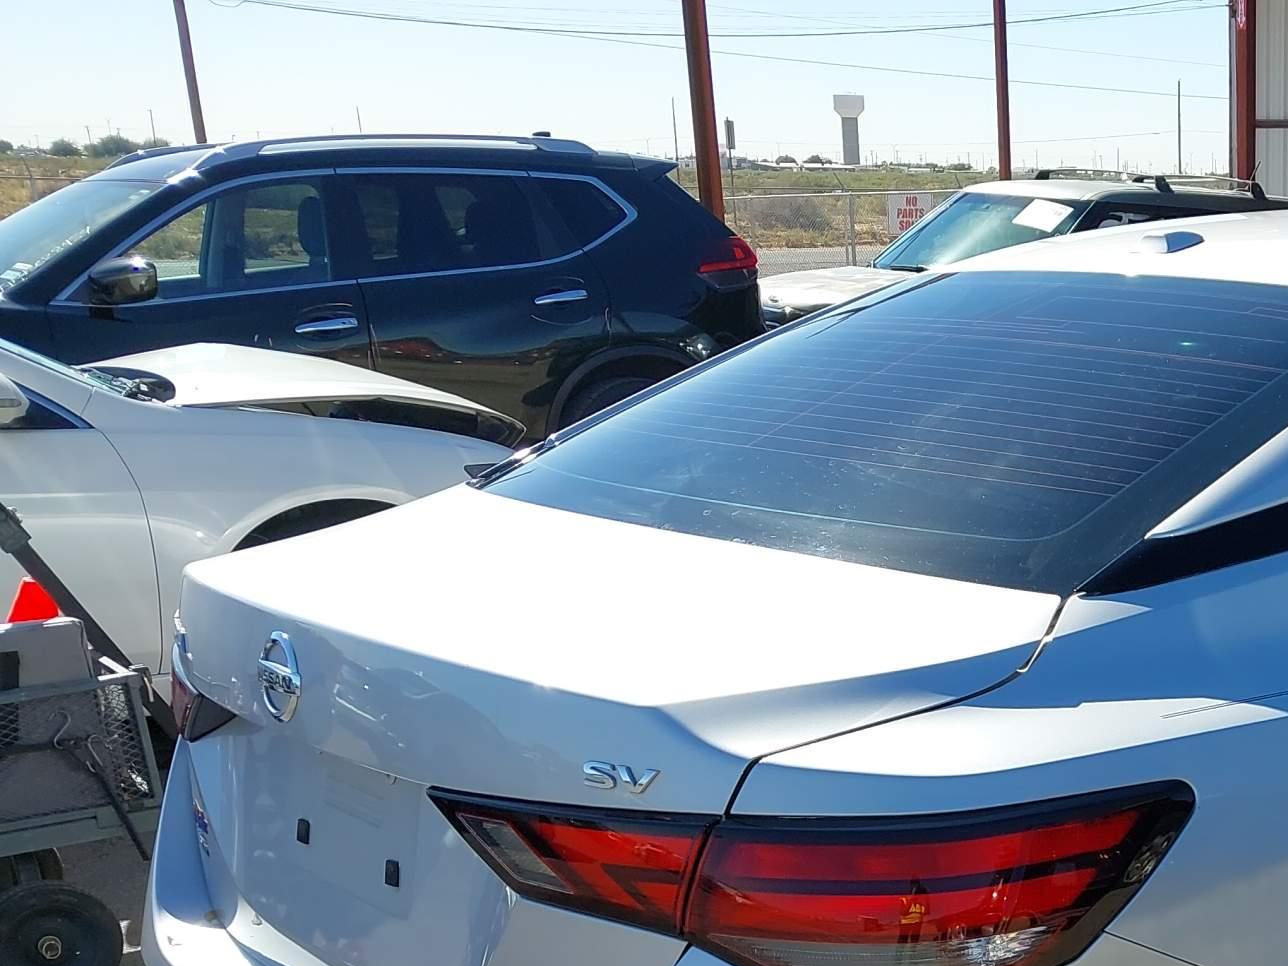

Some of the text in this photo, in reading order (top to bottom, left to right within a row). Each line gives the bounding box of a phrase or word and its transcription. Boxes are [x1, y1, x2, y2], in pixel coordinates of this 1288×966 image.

[905, 196, 918, 207] NO
[896, 208, 925, 219] PARTS
[583, 760, 661, 794] SV
